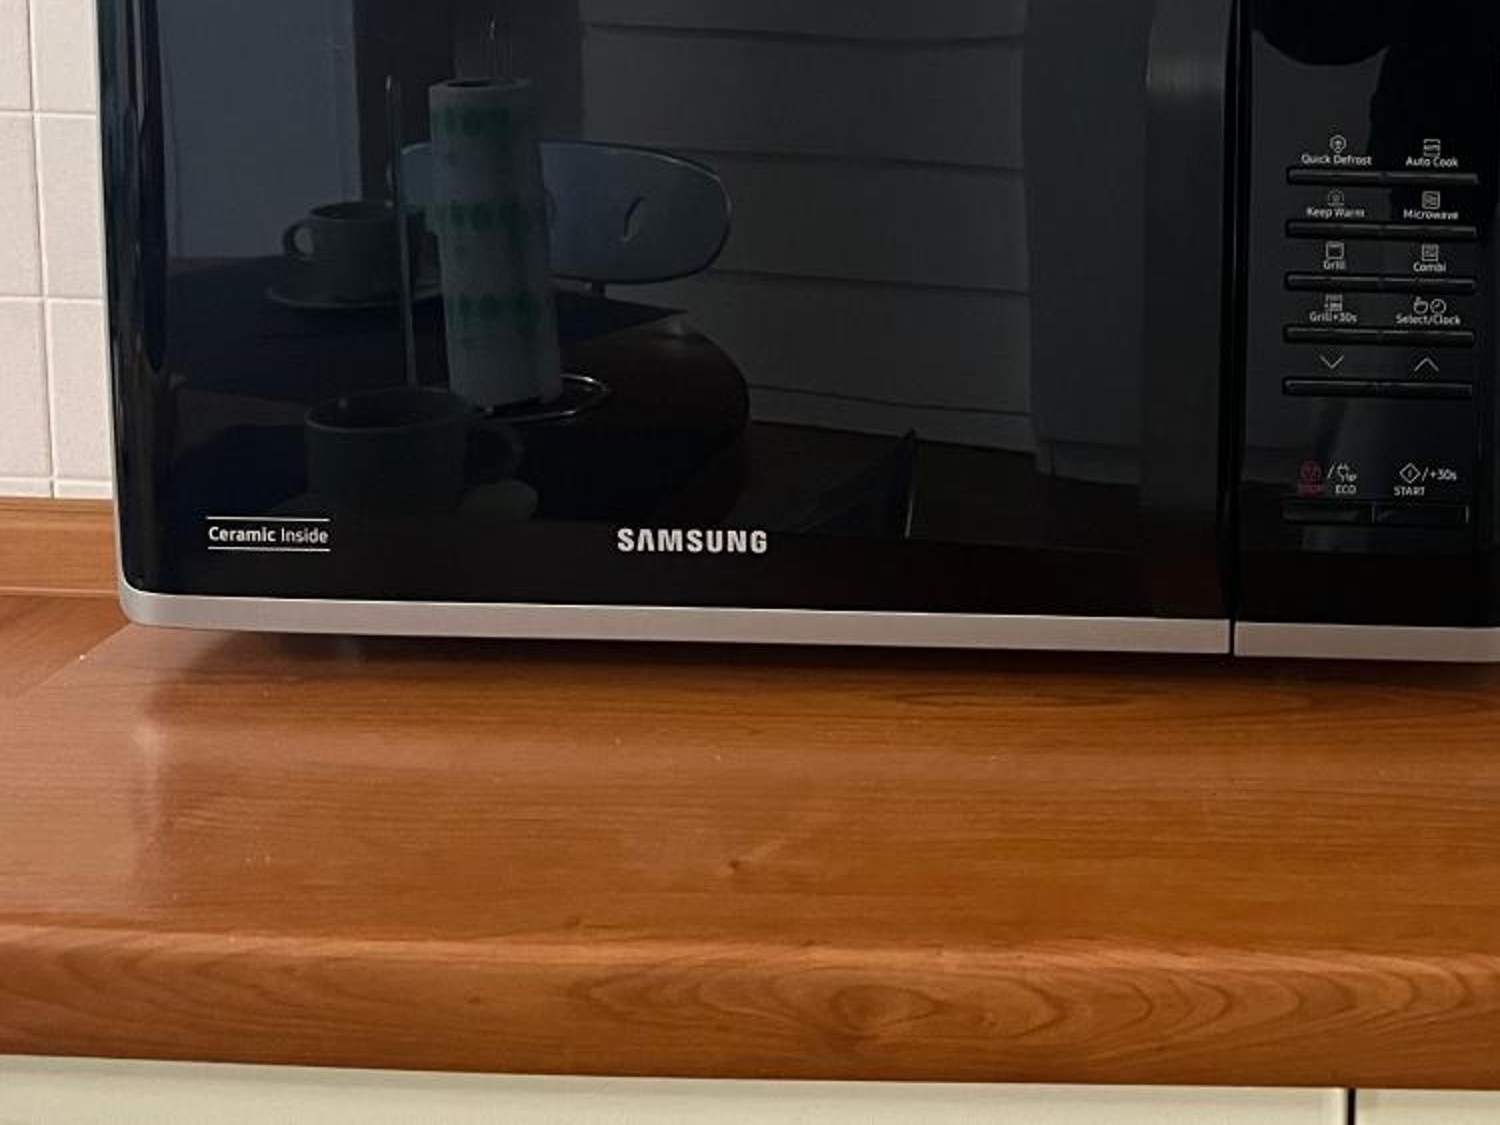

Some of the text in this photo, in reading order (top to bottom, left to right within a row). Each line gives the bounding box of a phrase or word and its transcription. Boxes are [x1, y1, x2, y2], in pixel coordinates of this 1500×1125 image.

[1301, 154, 1372, 166] Quick Defrost
[1405, 156, 1458, 168] Auto Cook
[1306, 207, 1365, 218] Keep Warm
[1403, 208, 1459, 220] Microwave
[1323, 260, 1346, 270] Grill
[1413, 261, 1446, 272] Combi
[1396, 313, 1461, 325] Select/Clock
[1335, 485, 1357, 494] ECO
[1393, 486, 1425, 496] START
[208, 526, 329, 544] Ceramic Inside
[616, 528, 768, 555] SAMSUNG
